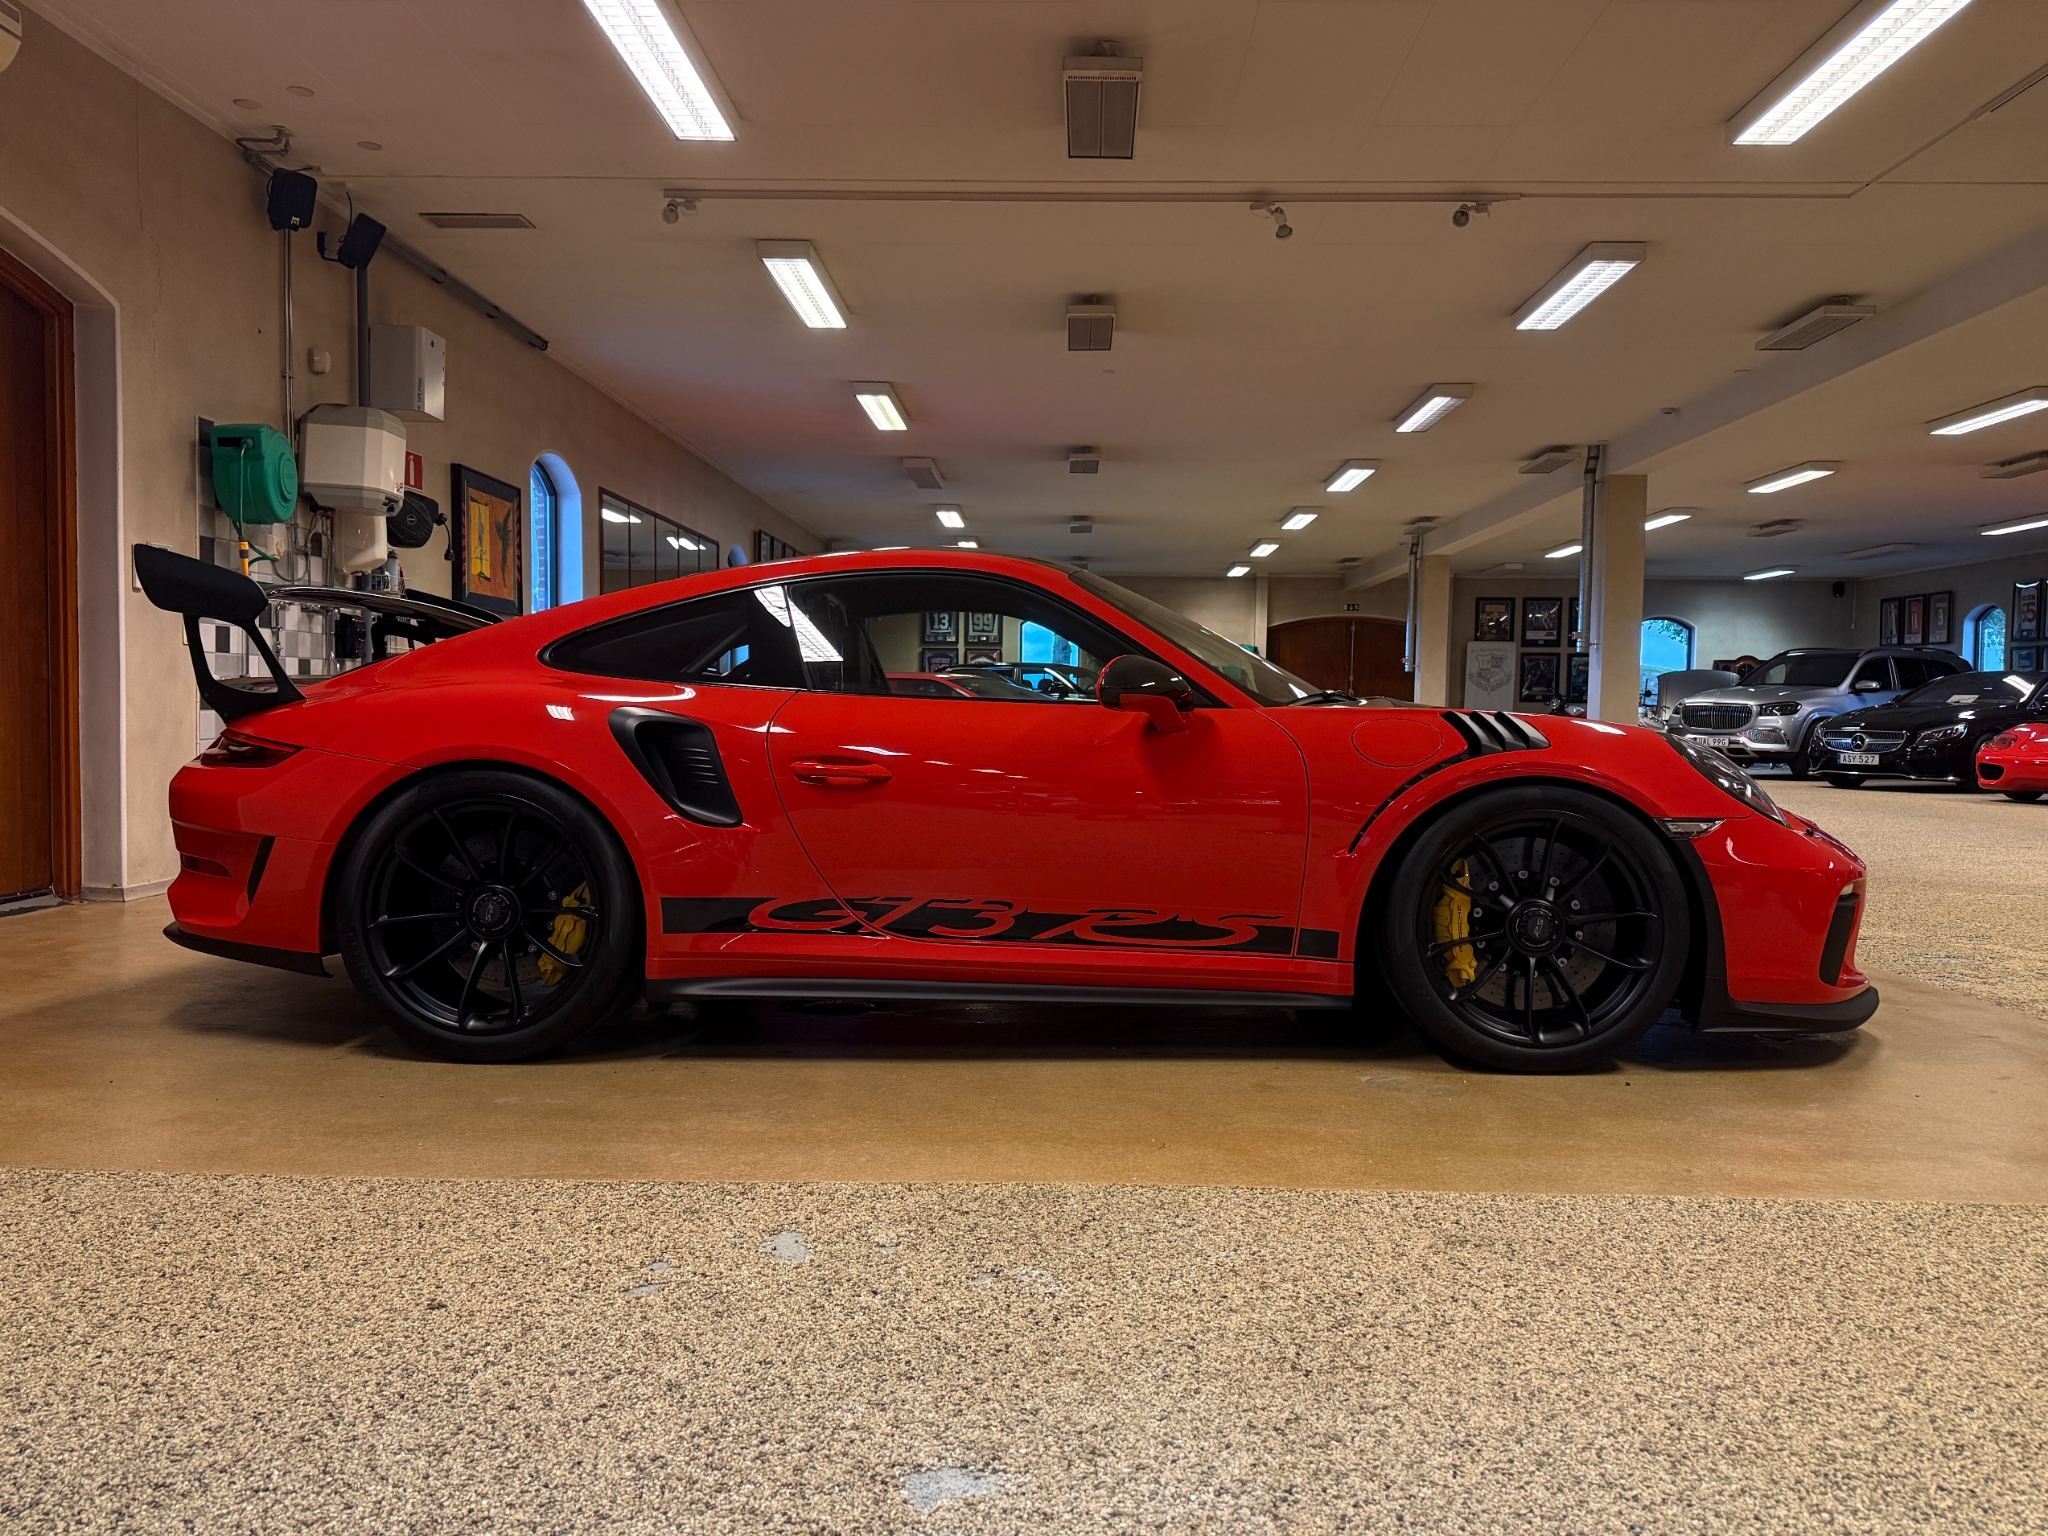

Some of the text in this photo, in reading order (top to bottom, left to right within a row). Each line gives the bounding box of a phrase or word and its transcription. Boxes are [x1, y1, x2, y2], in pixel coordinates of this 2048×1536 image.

[933, 612, 949, 630] 13
[973, 613, 994, 631] 99
[1712, 738, 1726, 746] 99G
[1842, 754, 1876, 764] ASY 527
[748, 897, 1285, 947] GT3 RS
